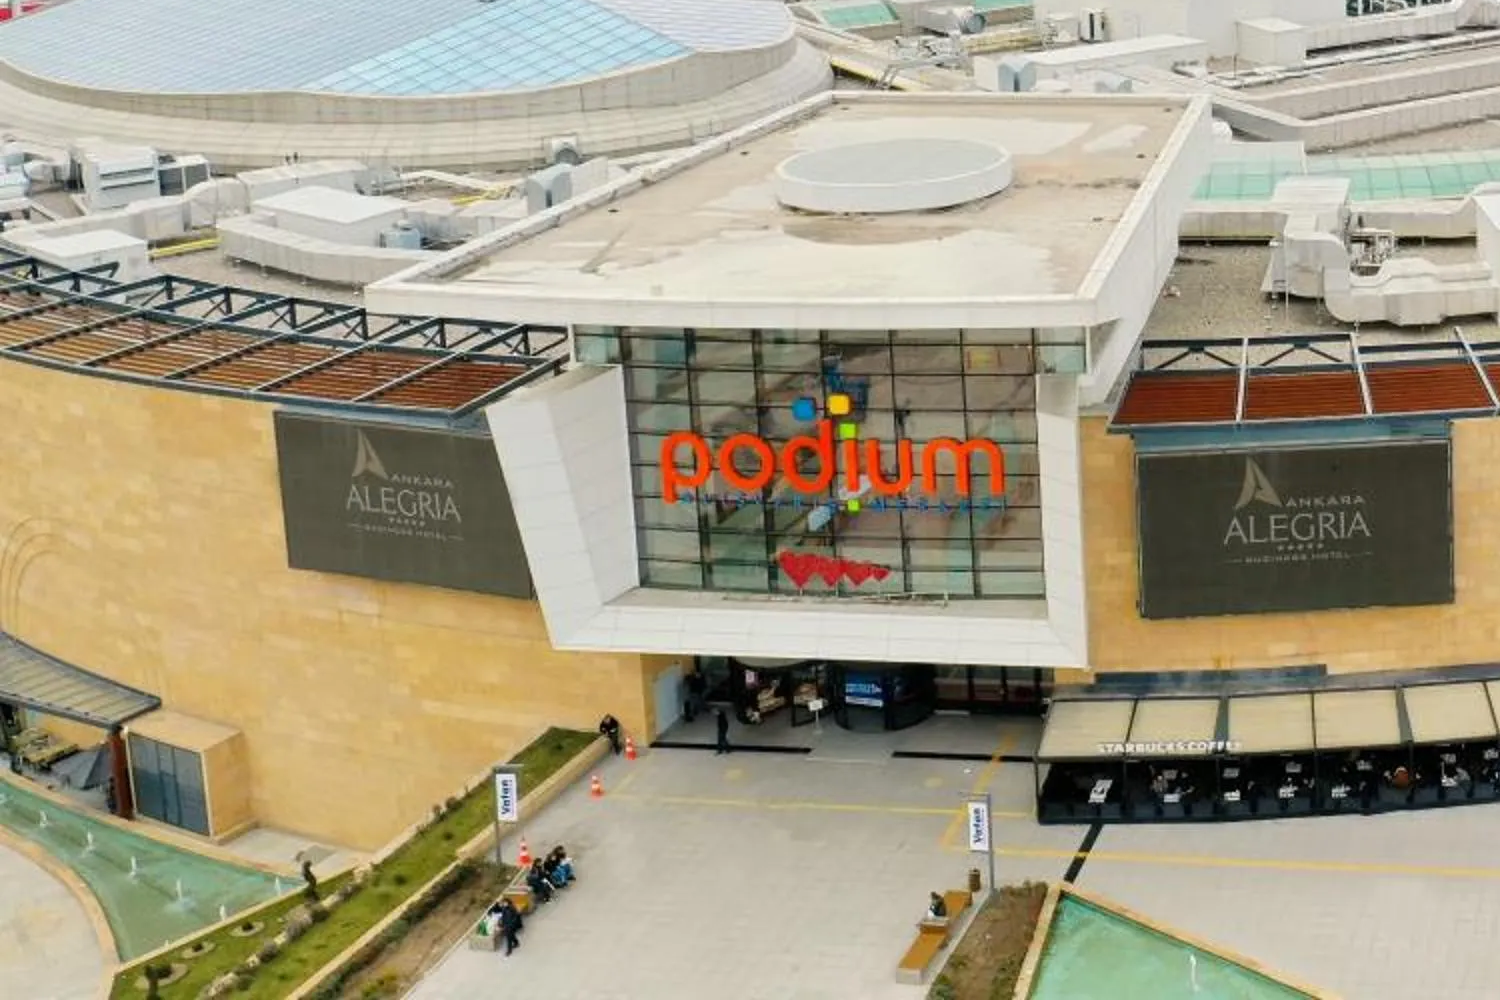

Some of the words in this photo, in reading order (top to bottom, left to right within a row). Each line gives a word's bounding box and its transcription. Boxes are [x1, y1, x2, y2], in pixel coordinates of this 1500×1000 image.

[661, 420, 1005, 504] podium
[390, 473, 455, 489] ANKARA
[346, 483, 463, 524] ALEGRIA
[1286, 494, 1367, 508] ANKARA
[1223, 510, 1372, 546] ALEGRIA
[1098, 741, 1185, 754] STARBUCKS
